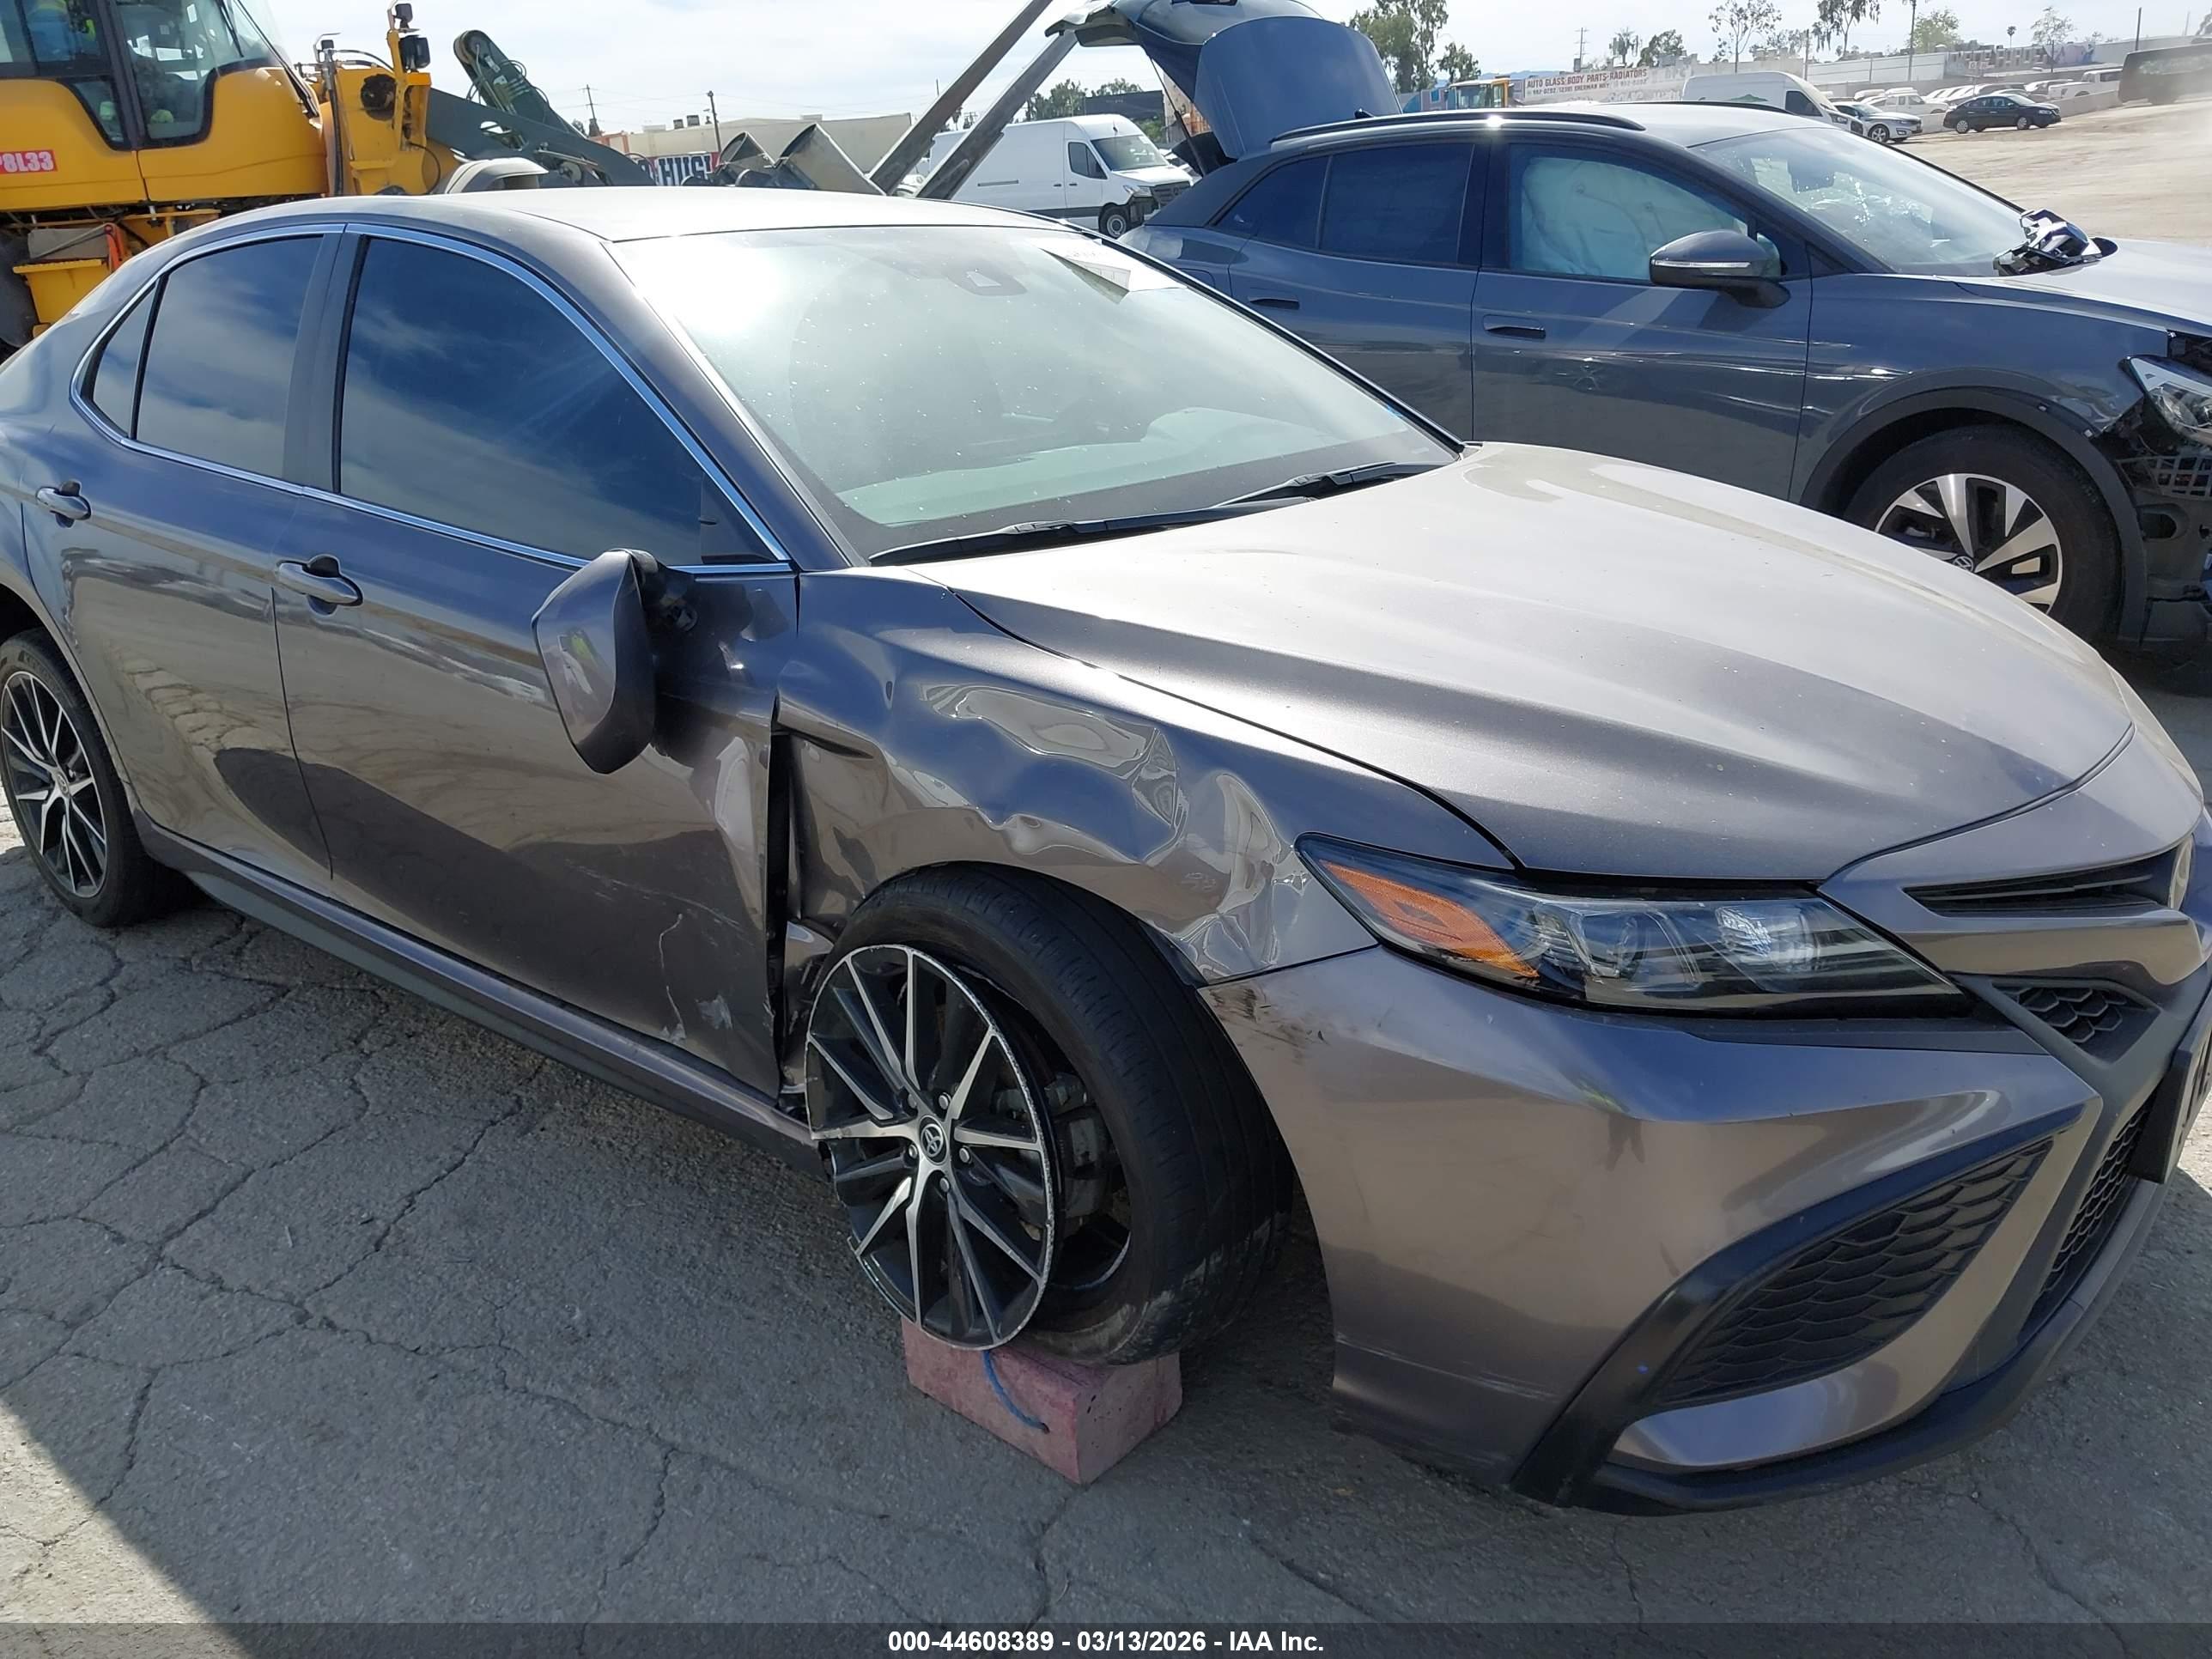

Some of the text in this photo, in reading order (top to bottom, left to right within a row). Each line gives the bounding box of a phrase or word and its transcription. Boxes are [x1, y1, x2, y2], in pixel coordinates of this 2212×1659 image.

[1528, 78, 1543, 88] AUTO
[1546, 76, 1565, 87] GLASS
[1610, 69, 1647, 81] RADIATORS
[0, 151, 54, 173] 8L33
